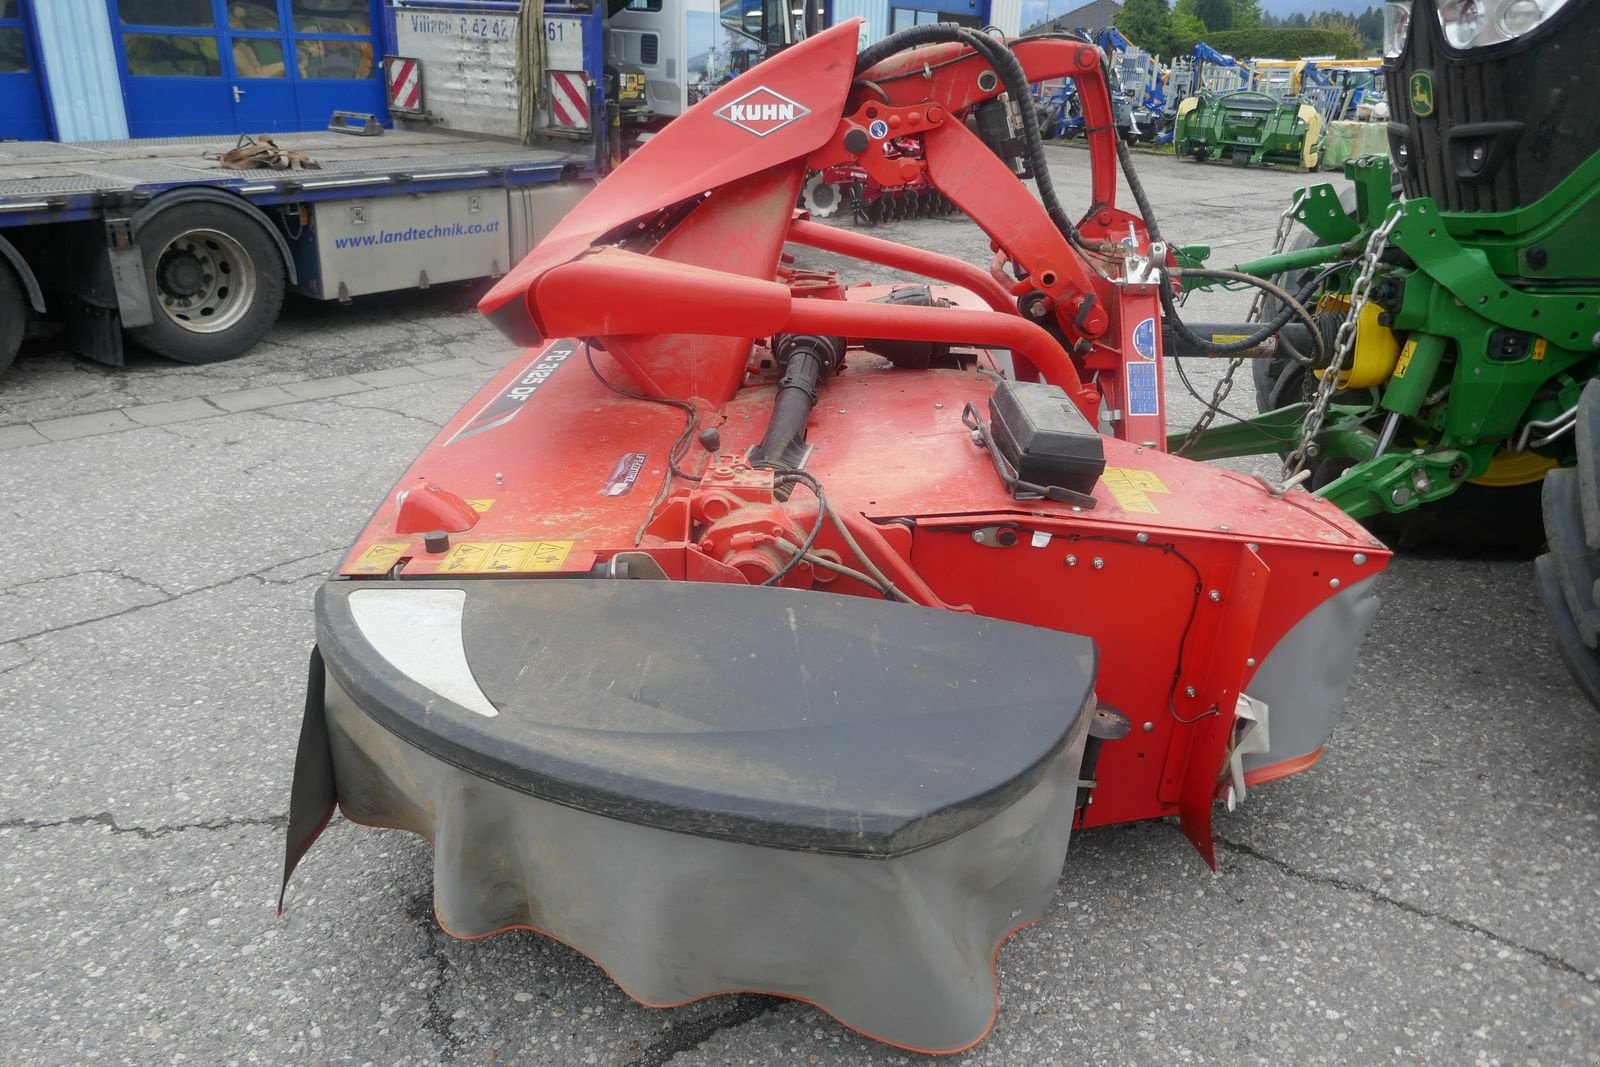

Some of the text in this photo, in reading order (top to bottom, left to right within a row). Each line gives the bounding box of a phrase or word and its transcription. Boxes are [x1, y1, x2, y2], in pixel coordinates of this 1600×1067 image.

[472, 18, 487, 36] 42
[730, 103, 794, 121] KUHN
[335, 220, 500, 249] www.landtechnik.co.at
[506, 350, 572, 402] FC 3125 DF
